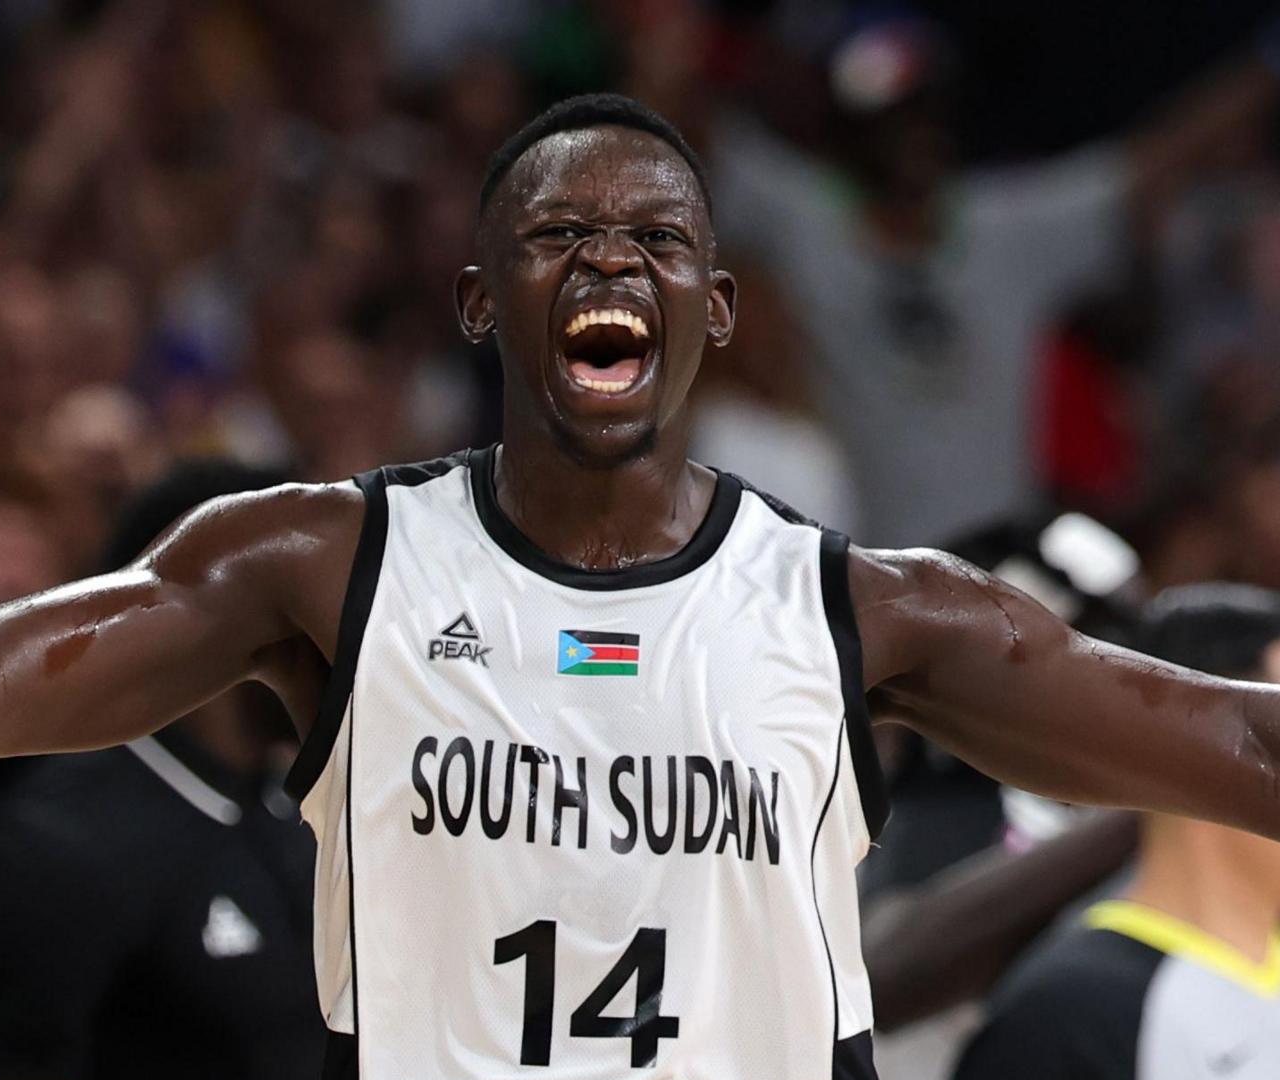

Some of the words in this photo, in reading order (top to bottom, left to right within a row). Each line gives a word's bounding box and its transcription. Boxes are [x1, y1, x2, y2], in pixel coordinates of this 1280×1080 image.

[428, 639, 493, 668] PEAK
[411, 736, 588, 850] SOUTH
[609, 755, 780, 866] SUDAN
[494, 920, 679, 1068] 14
